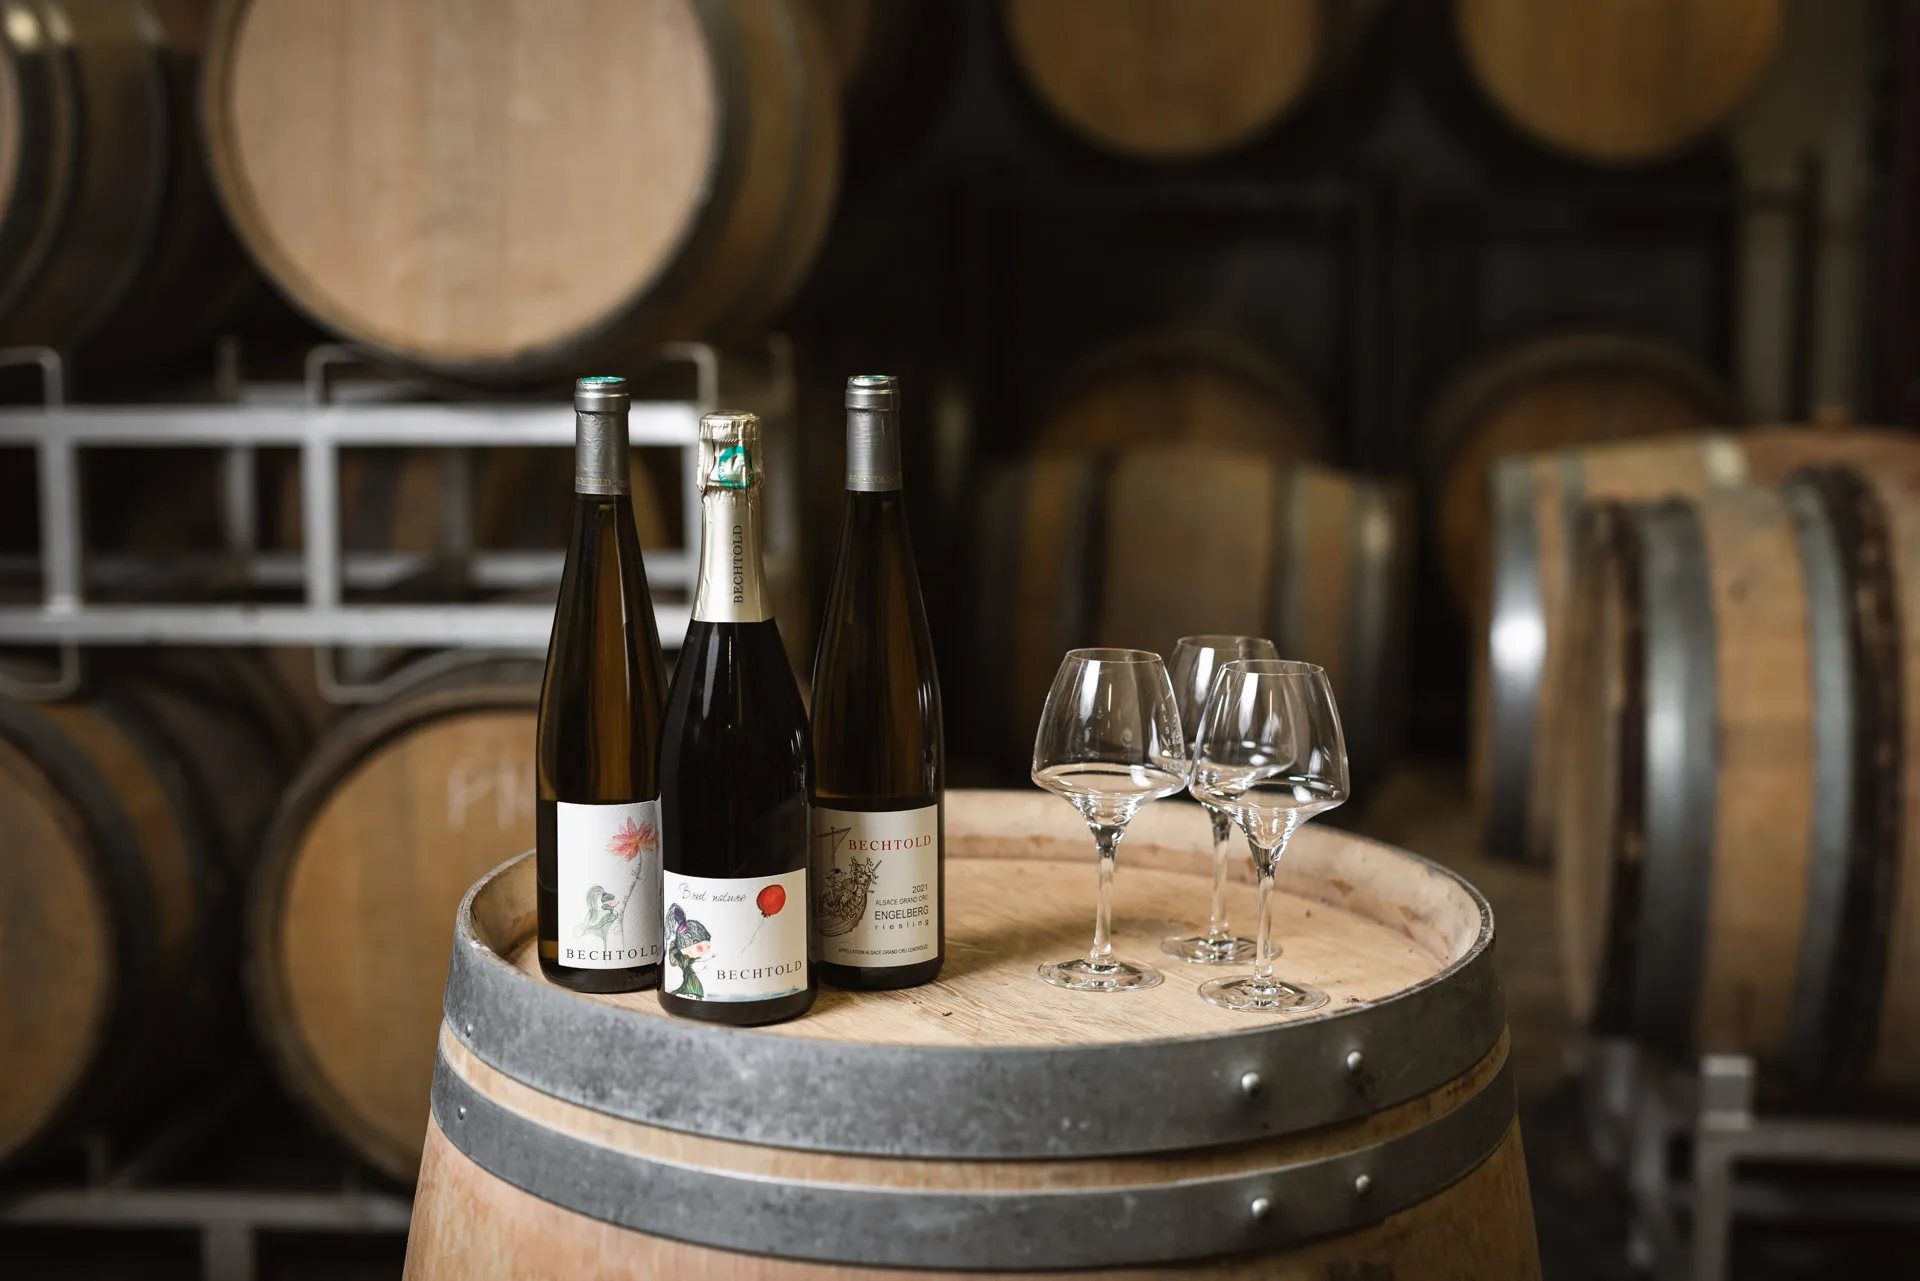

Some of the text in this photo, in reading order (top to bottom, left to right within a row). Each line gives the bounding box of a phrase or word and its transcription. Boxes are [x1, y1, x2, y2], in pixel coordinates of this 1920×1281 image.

[732, 524, 743, 604] BECHTOLD
[849, 835, 931, 851] BECHTOLD
[679, 883, 747, 903] Brut nature
[912, 884, 928, 893] 2021
[875, 894, 928, 906] ALSACE GRAND CRU
[874, 905, 929, 920] ENGELBERG
[875, 919, 929, 930] riesling
[565, 944, 658, 961] BECHTOLD
[717, 960, 803, 980] BECHTOLD
